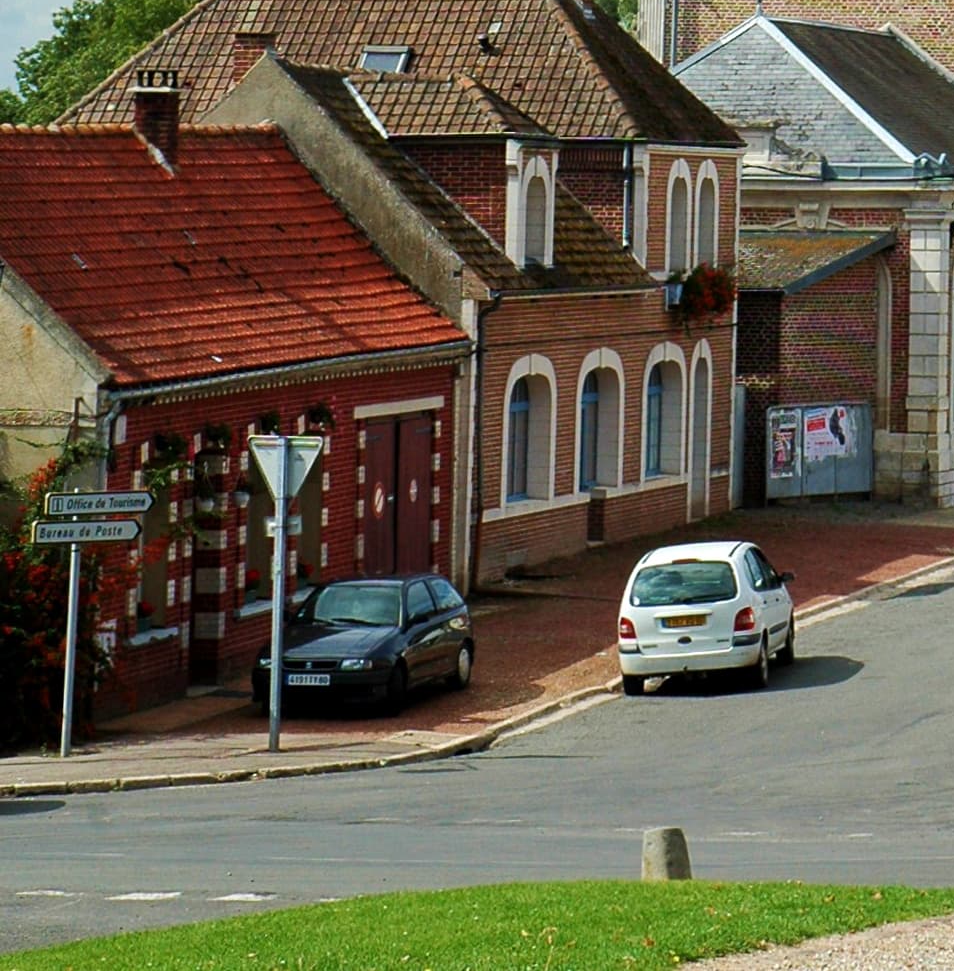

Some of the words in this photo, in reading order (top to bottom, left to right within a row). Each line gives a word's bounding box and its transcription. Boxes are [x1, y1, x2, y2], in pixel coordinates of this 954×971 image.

[66, 498, 93, 510] Office
[95, 497, 105, 508] de
[109, 495, 146, 508] Tourisme
[39, 527, 74, 539] Bureau
[79, 525, 90, 536] de
[95, 525, 123, 536] Poste
